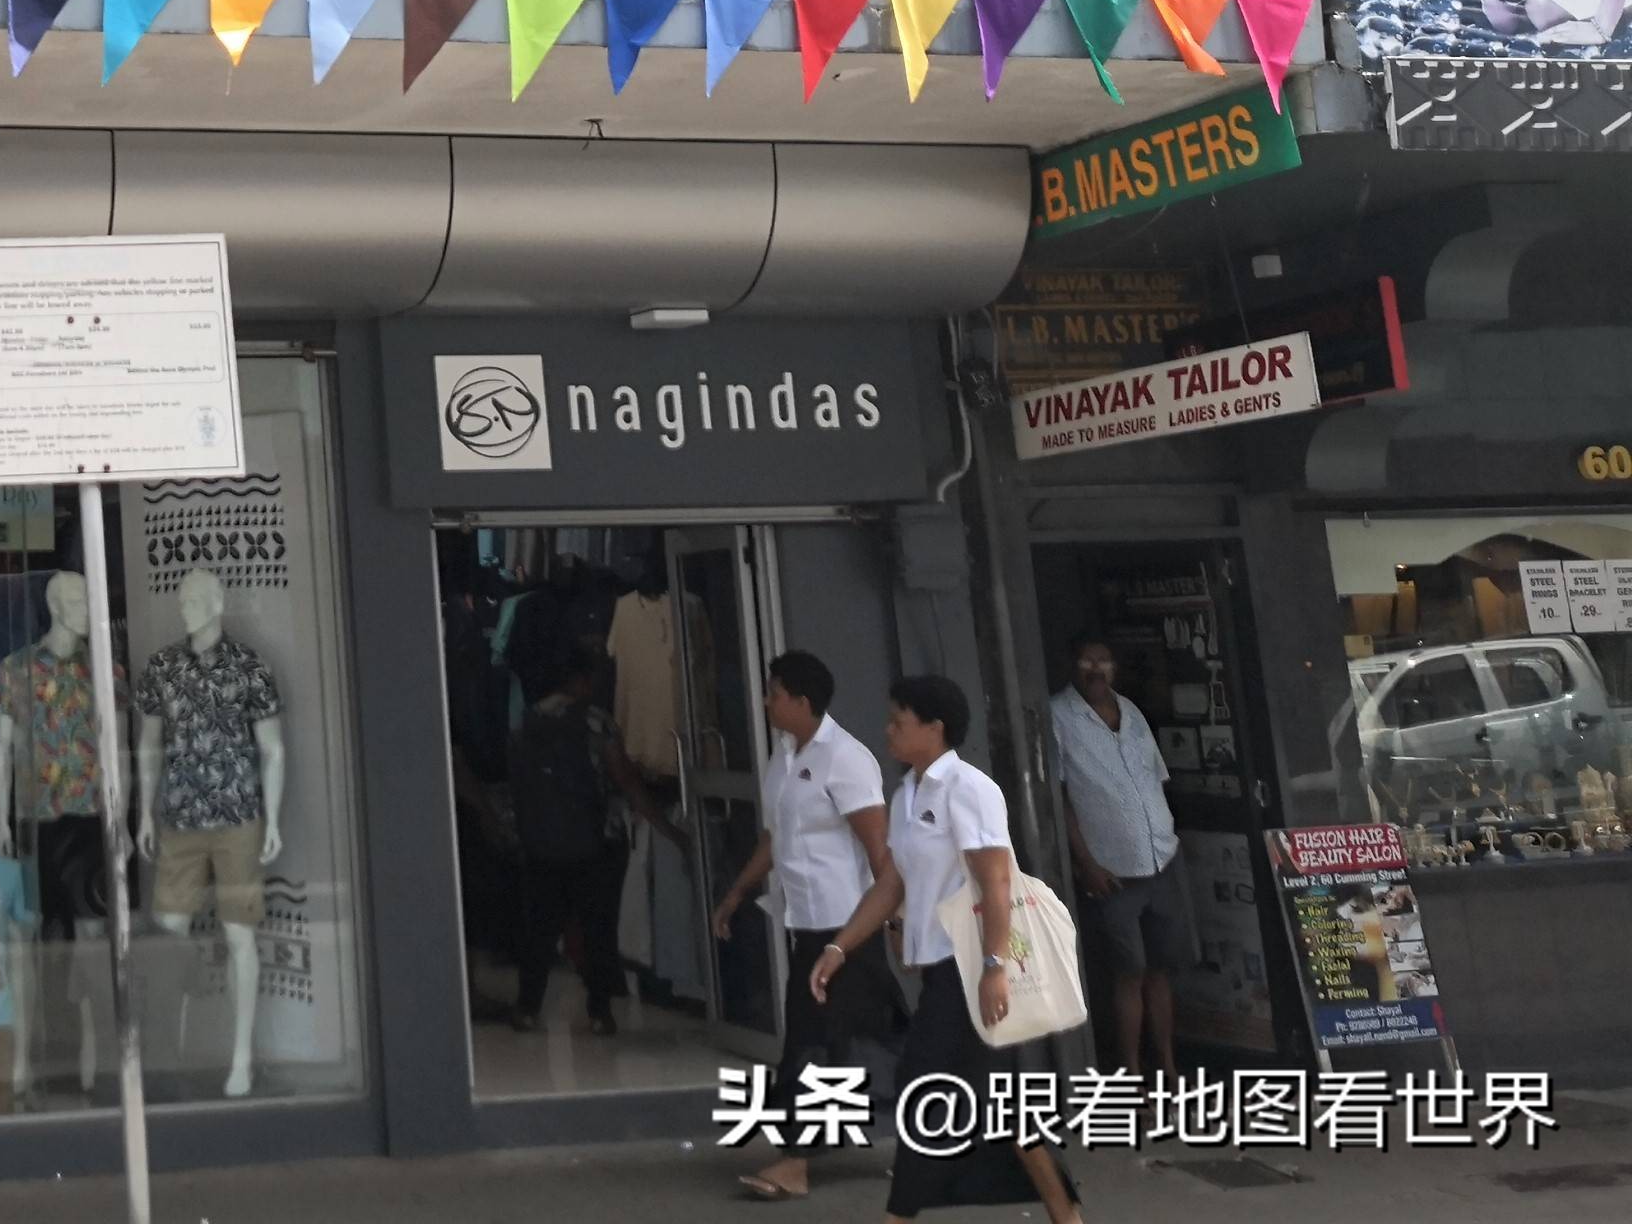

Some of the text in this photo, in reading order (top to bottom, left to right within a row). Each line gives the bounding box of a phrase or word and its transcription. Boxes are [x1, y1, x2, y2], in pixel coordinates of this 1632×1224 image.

[1024, 344, 1293, 429] VINAYAK TAILOR
[568, 371, 881, 450] nagindas
[1042, 391, 1282, 450] MADE TO MEASURE LADIES & GENTS
[1578, 444, 1632, 480] 60
[1530, 577, 1556, 586] STEEL
[1573, 576, 1600, 585] STEEL
[1531, 589, 1559, 598] RINGS
[1568, 588, 1607, 596] BRACELET
[1294, 827, 1398, 850] FUSION HAIR &
[1297, 844, 1402, 868] BEAUTY SALON
[1283, 875, 1309, 888] Level
[1379, 868, 1407, 881] Street
[1307, 905, 1329, 917] Hair
[1321, 959, 1351, 972] Facial
[1324, 974, 1351, 986] Nails
[1328, 986, 1369, 1000] Perming
